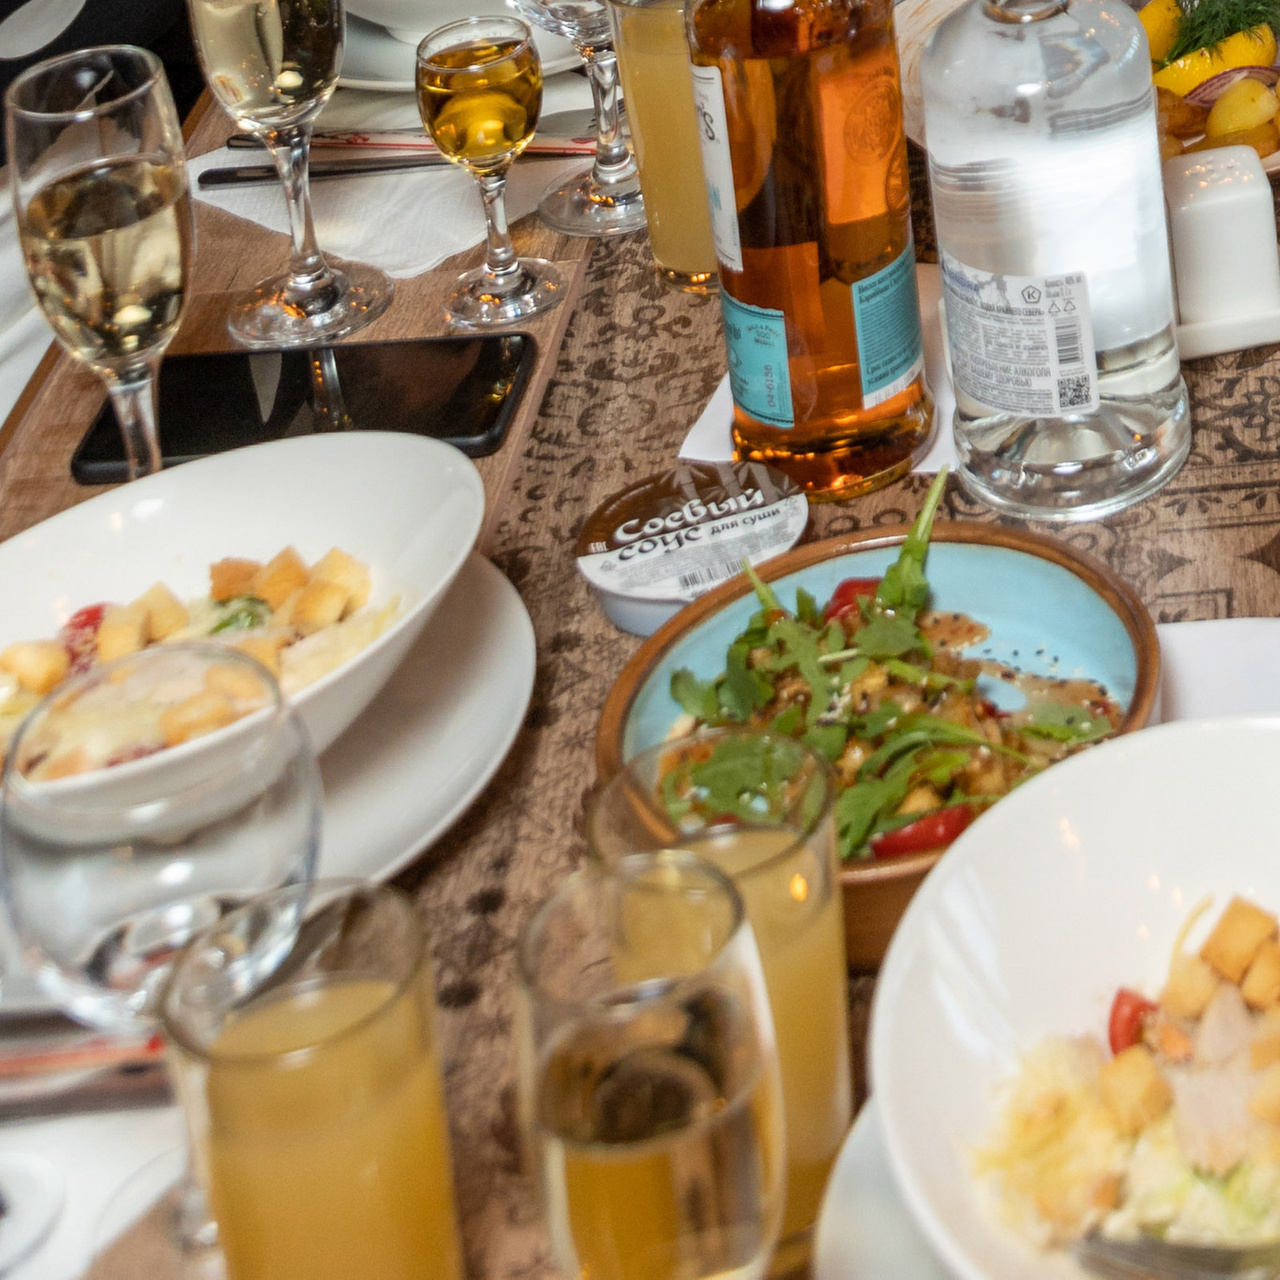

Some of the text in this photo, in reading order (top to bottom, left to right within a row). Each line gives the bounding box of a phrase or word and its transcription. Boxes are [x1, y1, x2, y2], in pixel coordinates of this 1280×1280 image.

[1014, 366, 1051, 378] АЛКОГОЛЯ
[613, 488, 765, 541] Соевый
[618, 507, 781, 561] соус для суши
